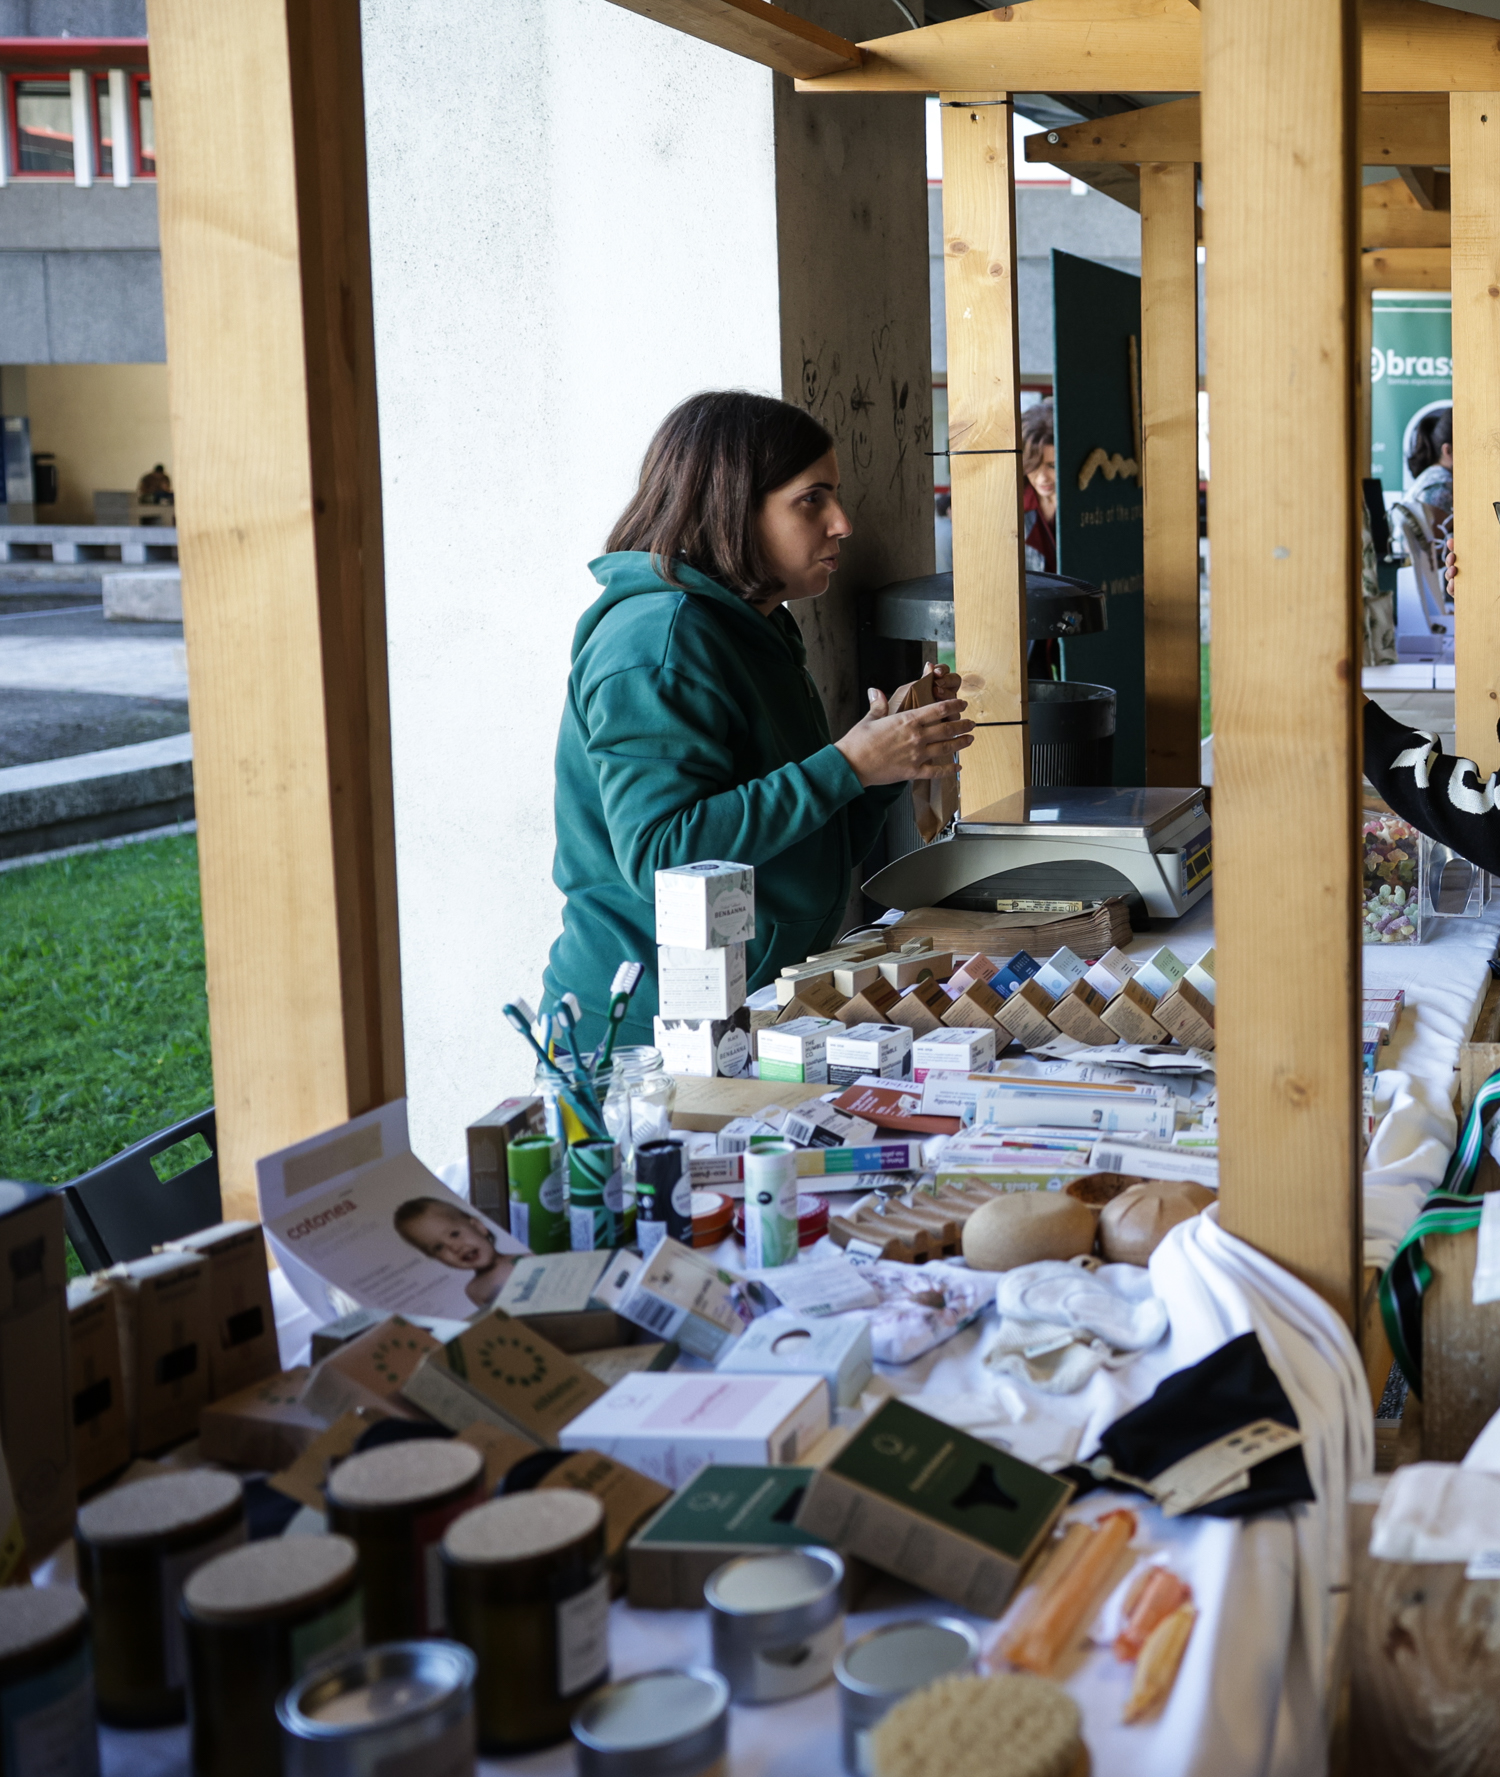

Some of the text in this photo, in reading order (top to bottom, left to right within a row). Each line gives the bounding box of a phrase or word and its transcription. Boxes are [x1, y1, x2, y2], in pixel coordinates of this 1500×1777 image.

[1386, 348, 1454, 377] bras
[714, 905, 747, 919] BEN&ANNA
[286, 1199, 357, 1240] cotonea
